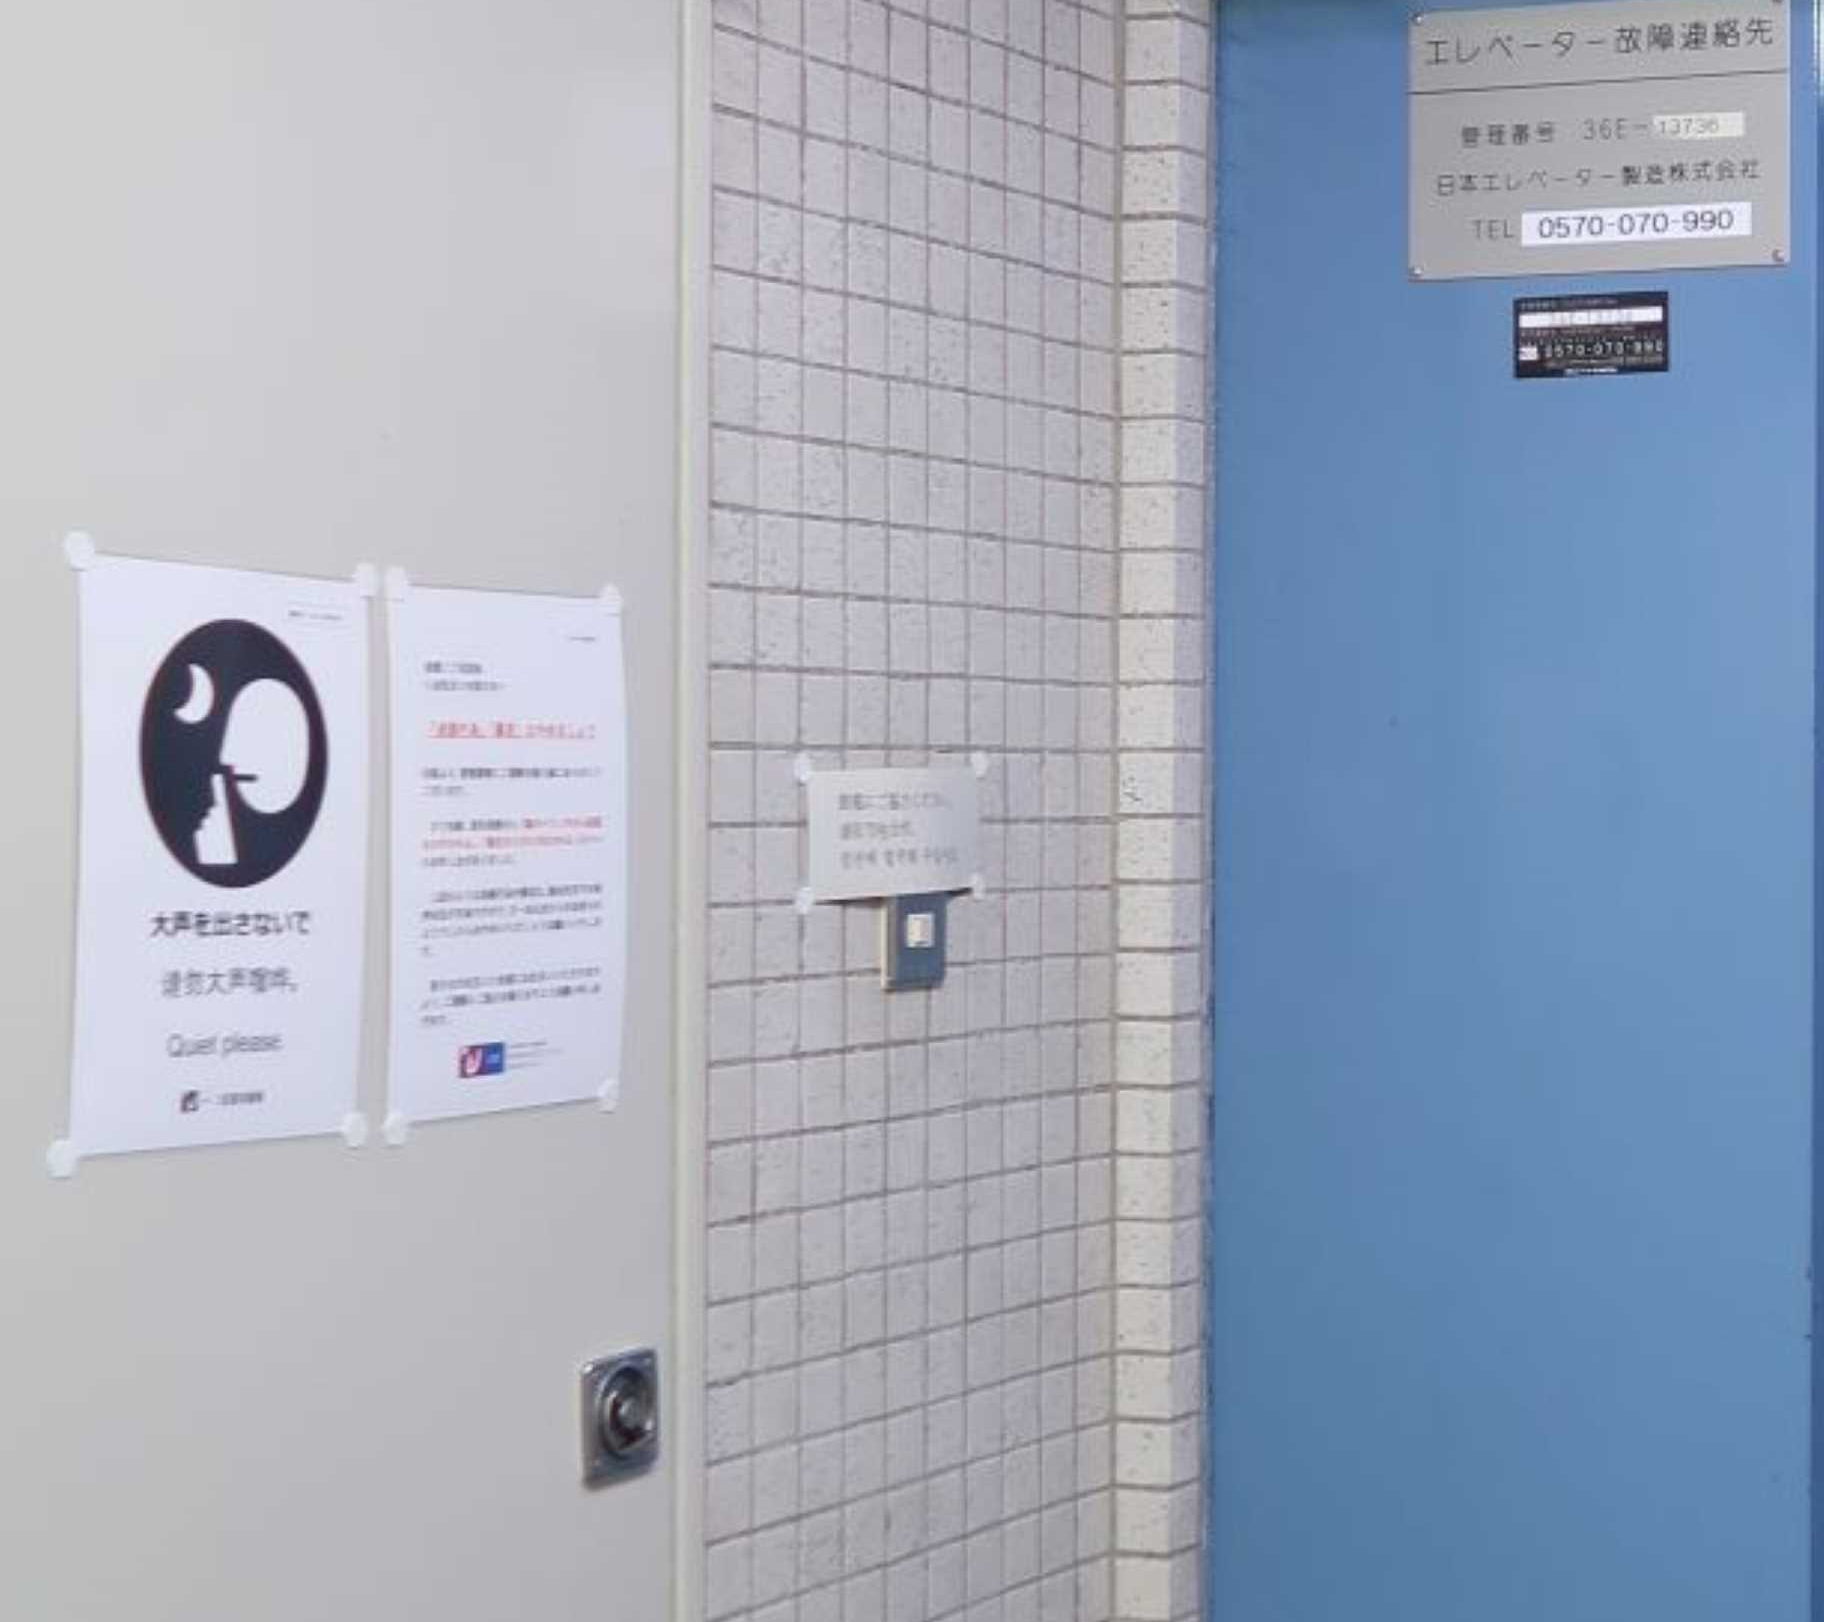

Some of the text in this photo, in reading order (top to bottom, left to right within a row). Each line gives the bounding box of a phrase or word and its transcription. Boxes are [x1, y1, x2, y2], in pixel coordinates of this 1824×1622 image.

[1424, 17, 1774, 66] エレベーター故障連絡先
[1437, 160, 1760, 197] 日本エレベーター製造株式会社
[1471, 208, 1735, 241] TEL 0570-070-990
[151, 910, 310, 937] 大声を出さないで
[167, 1032, 218, 1058] Quiet
